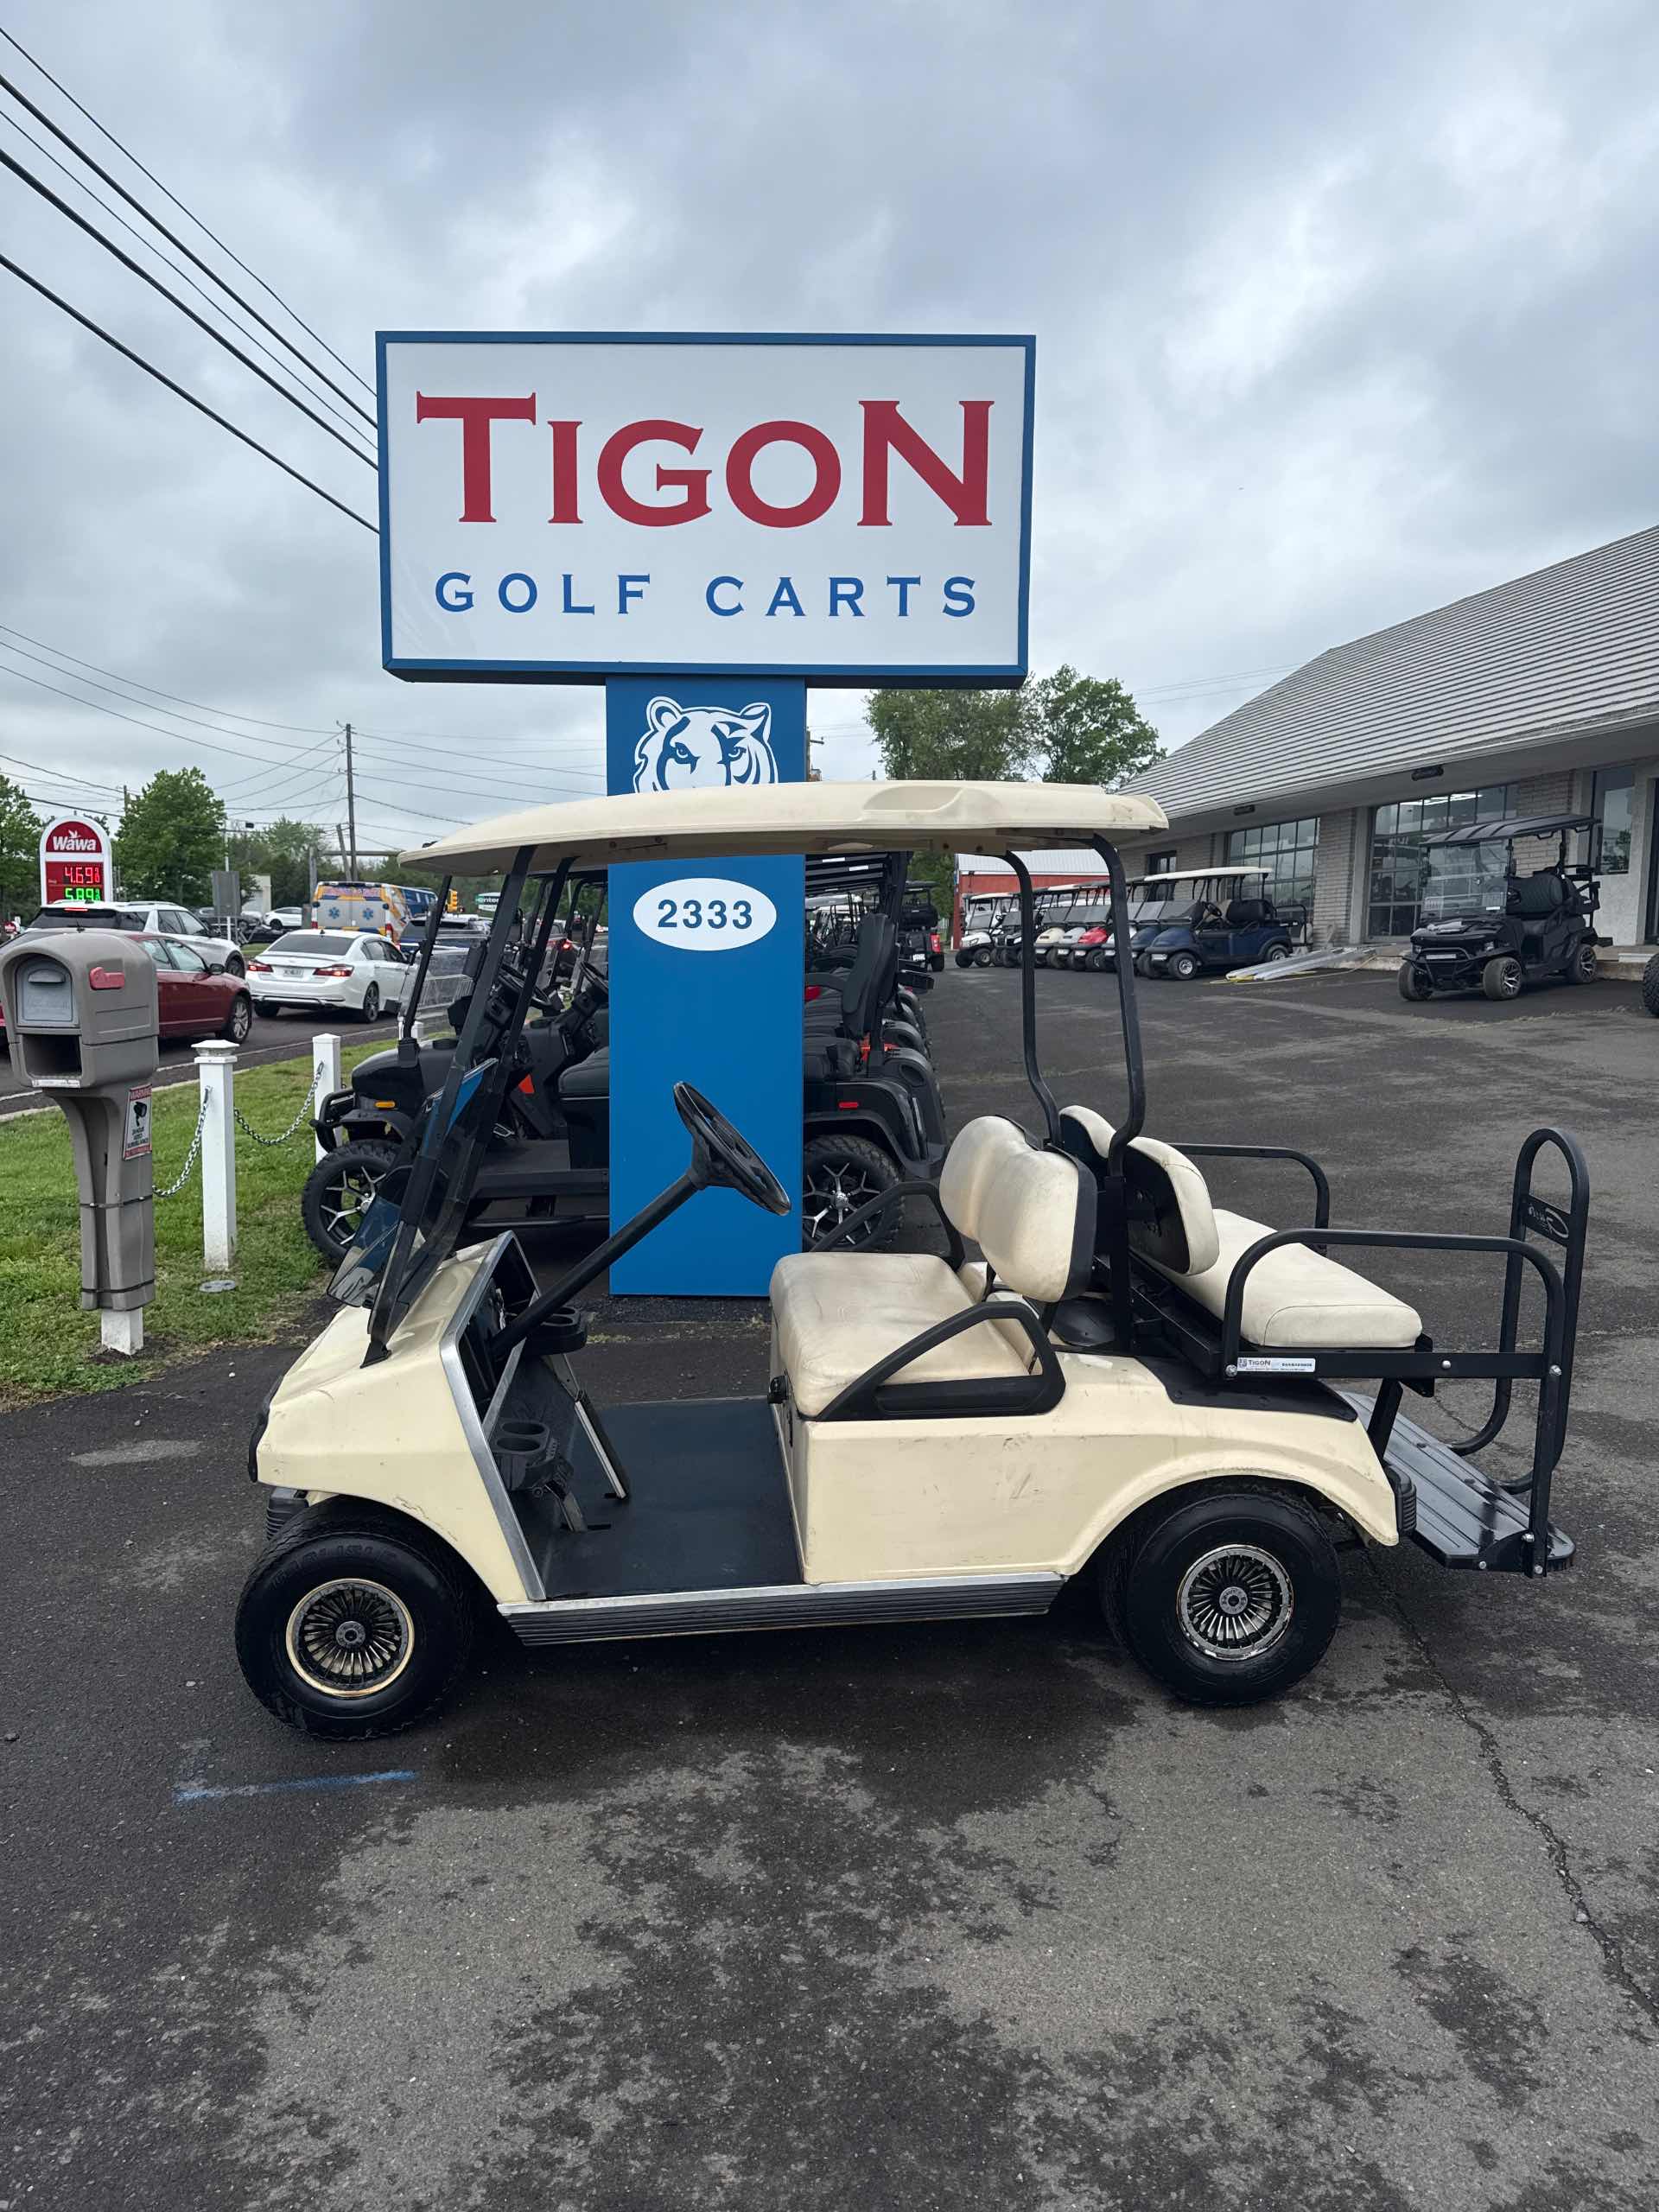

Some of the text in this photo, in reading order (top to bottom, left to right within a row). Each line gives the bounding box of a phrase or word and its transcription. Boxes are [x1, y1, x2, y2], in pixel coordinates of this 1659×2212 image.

[416, 392, 995, 528] TIGON
[435, 571, 976, 617] GOLF CARTS
[53, 836, 96, 850] Wawa
[657, 899, 753, 930] 2333
